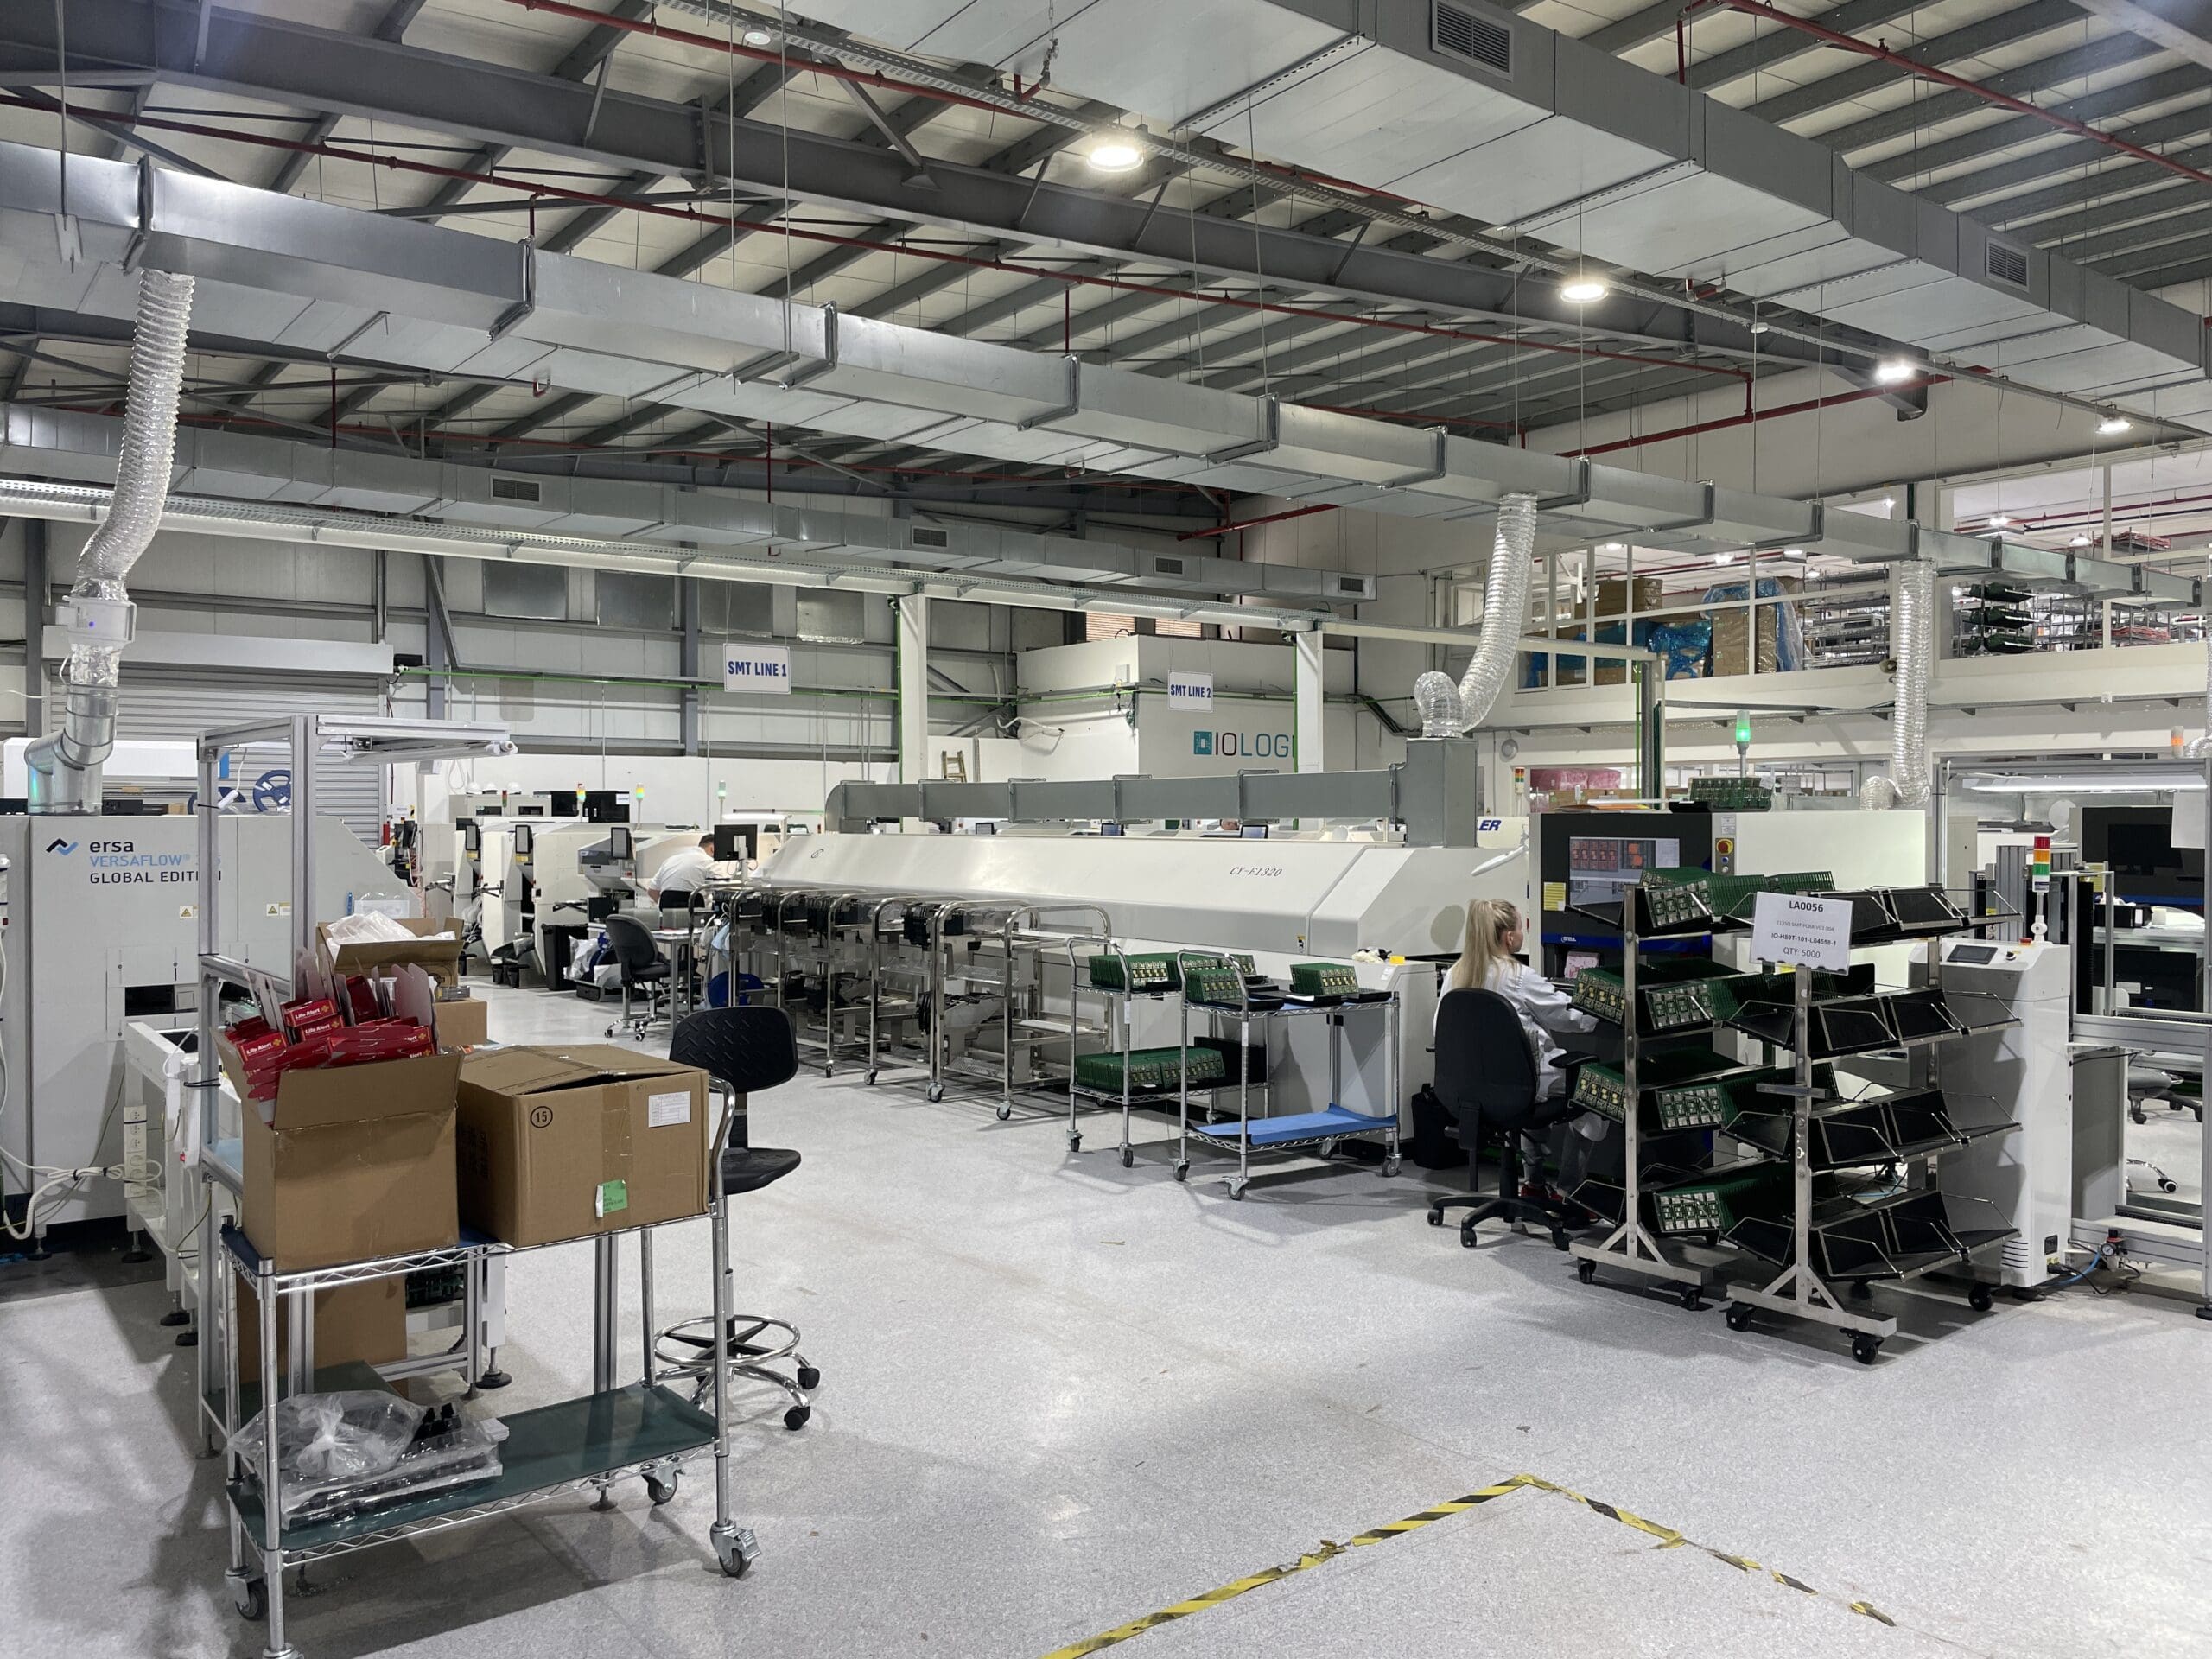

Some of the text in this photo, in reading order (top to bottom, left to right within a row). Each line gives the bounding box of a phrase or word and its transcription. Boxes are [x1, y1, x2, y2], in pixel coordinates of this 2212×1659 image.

[728, 661, 786, 677] SMT LINE 1
[1170, 684, 1211, 698] SMT LINE 2
[1215, 732, 1294, 758] IOLOGI
[1477, 819, 1502, 831] ER
[89, 841, 134, 853] ersa
[90, 871, 221, 884] GLOBAL EDITI
[1789, 900, 1824, 912] LA0056
[1802, 949, 1821, 959] 5000
[306, 1007, 321, 1016] Alert
[536, 1110, 547, 1123] 15
